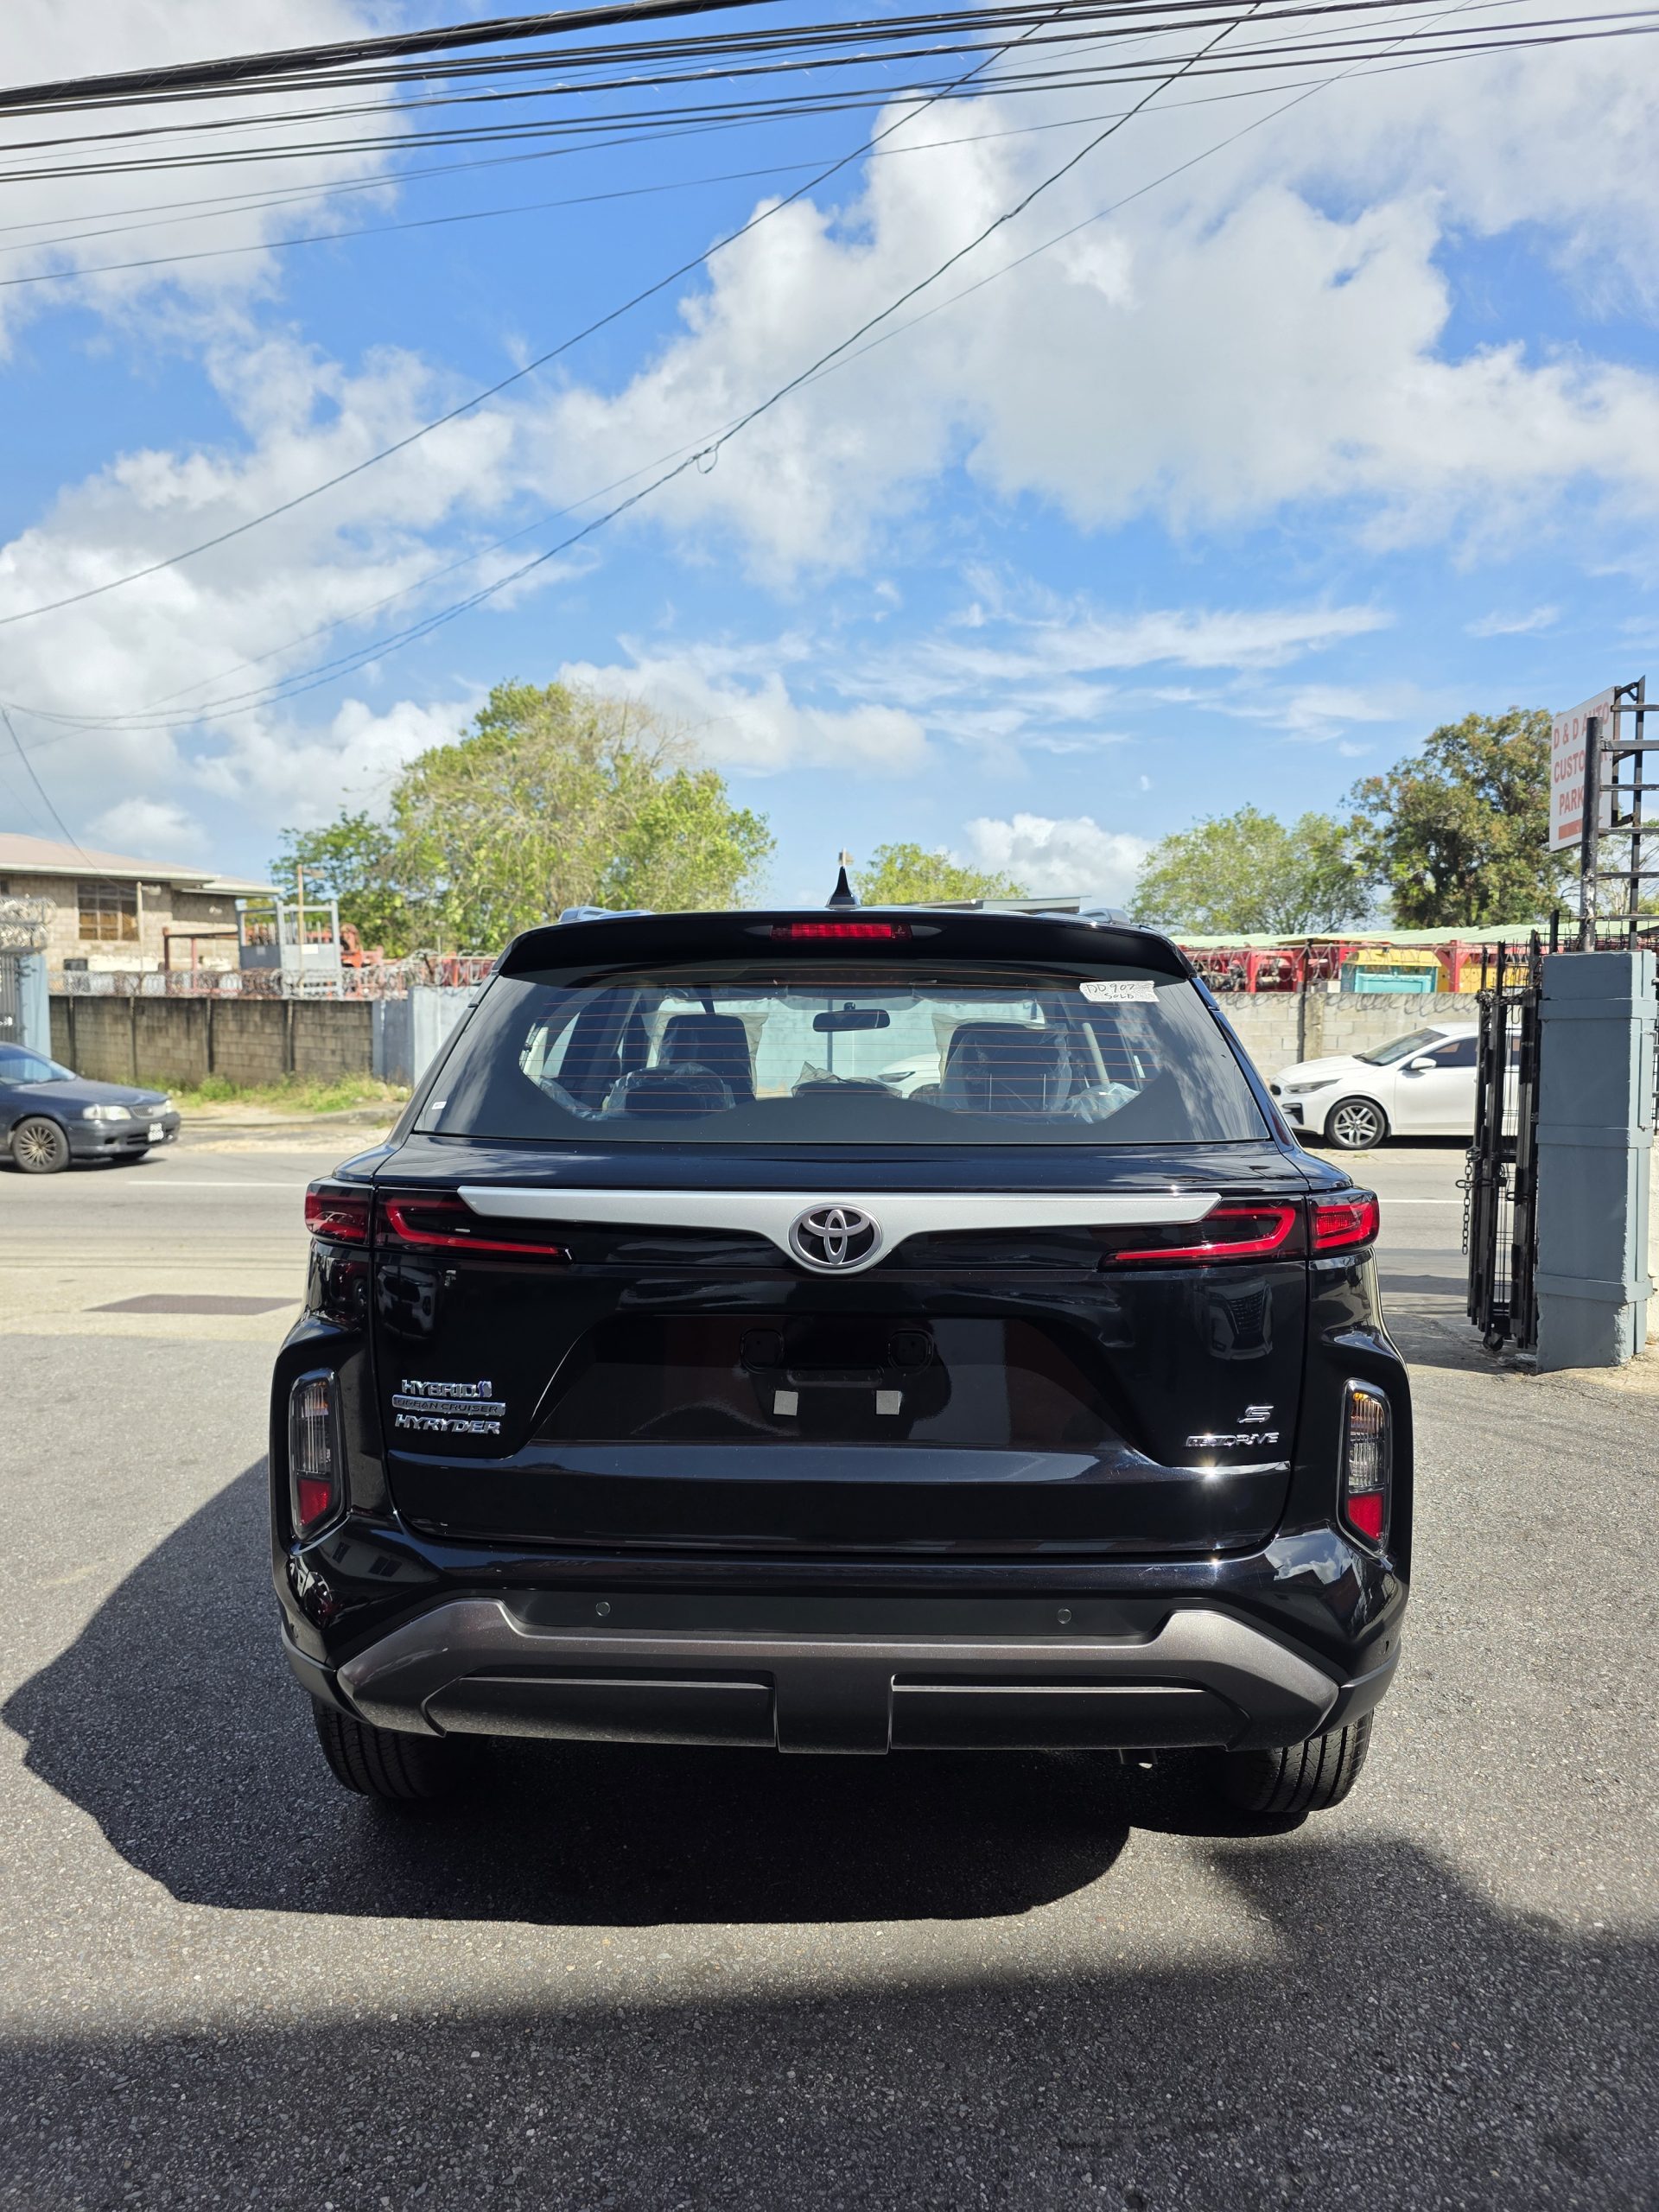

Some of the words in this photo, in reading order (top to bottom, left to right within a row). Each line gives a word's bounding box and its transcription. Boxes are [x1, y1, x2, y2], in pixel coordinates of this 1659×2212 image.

[1554, 727, 1560, 750] D
[1562, 722, 1569, 746] &
[1573, 717, 1579, 741] D
[1110, 983, 1135, 993] 907
[401, 1379, 477, 1397] HYBRID
[397, 1398, 438, 1410] URBAN
[441, 1403, 498, 1414] CRUISER
[395, 1414, 501, 1434] HYRYDER
